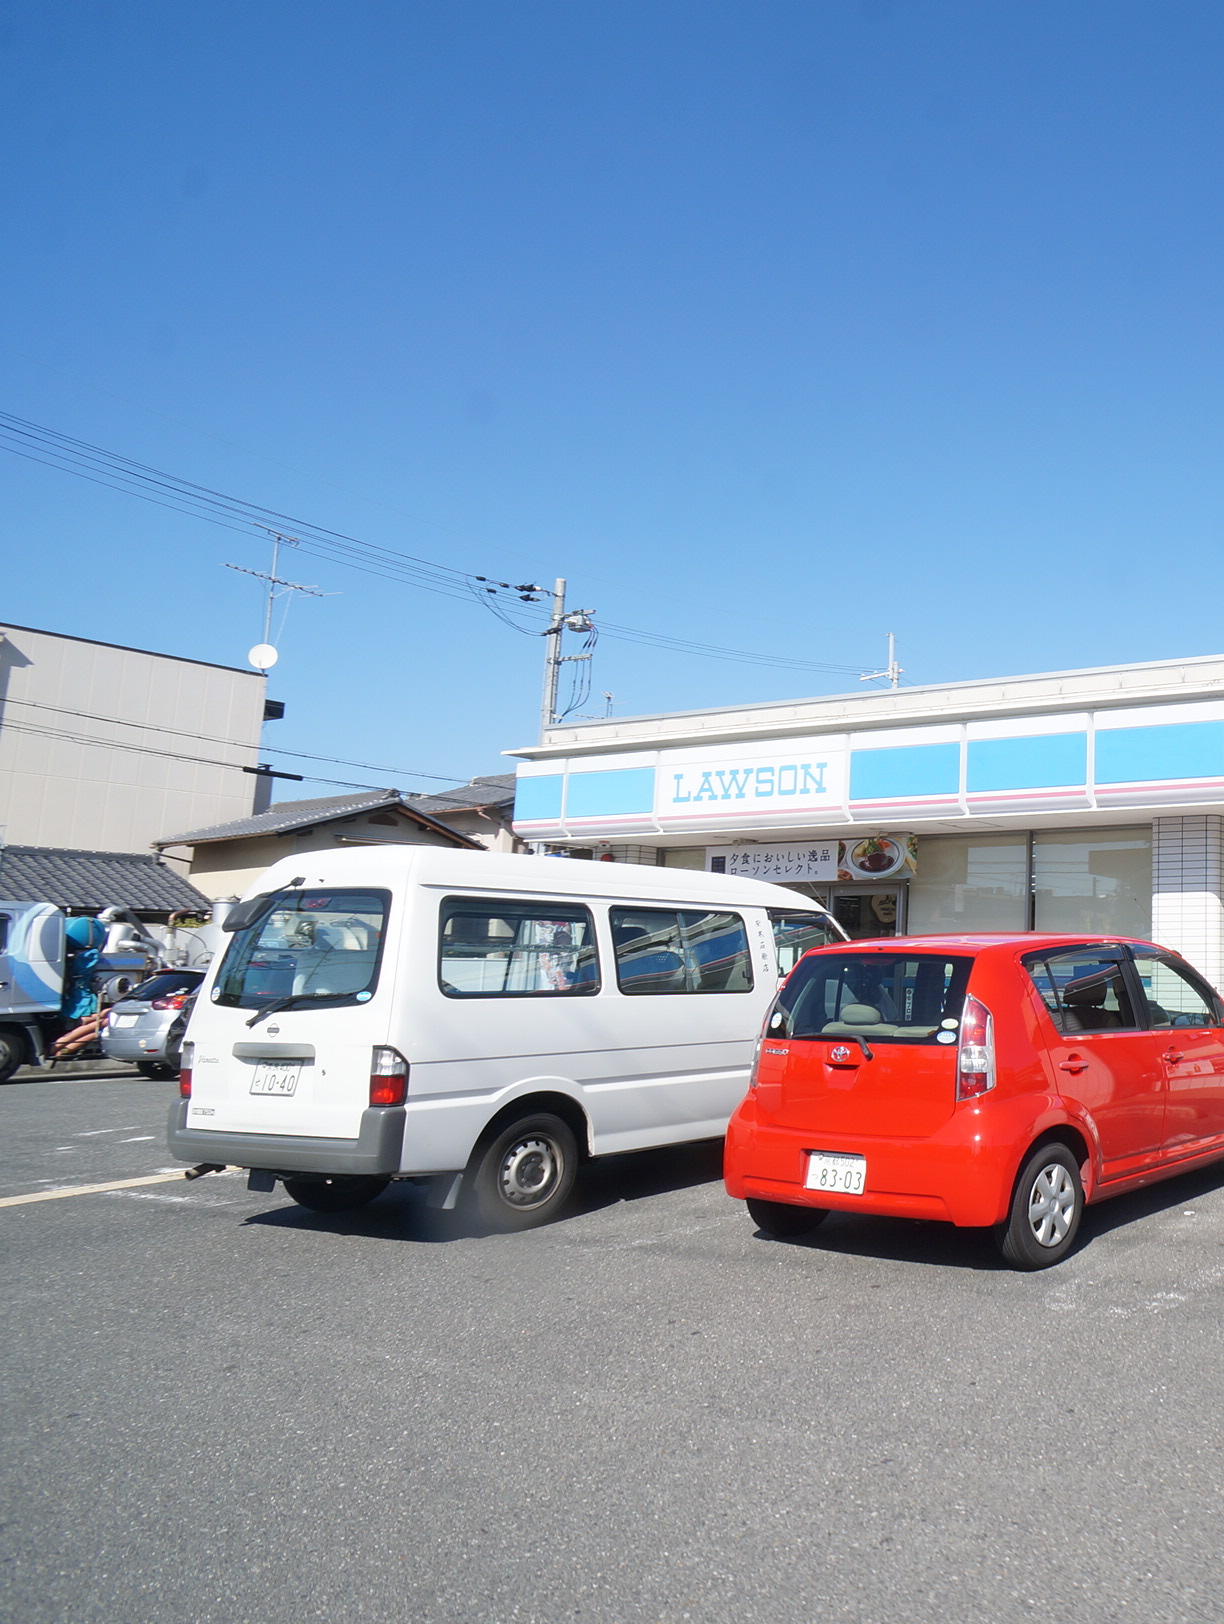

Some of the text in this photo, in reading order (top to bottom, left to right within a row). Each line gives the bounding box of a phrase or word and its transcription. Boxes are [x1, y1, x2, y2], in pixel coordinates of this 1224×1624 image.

[672, 762, 828, 803] LAWSON
[729, 849, 831, 866] 夕食においしい逸品
[262, 1074, 296, 1092] 10-40
[819, 1168, 863, 1191] 83-03
